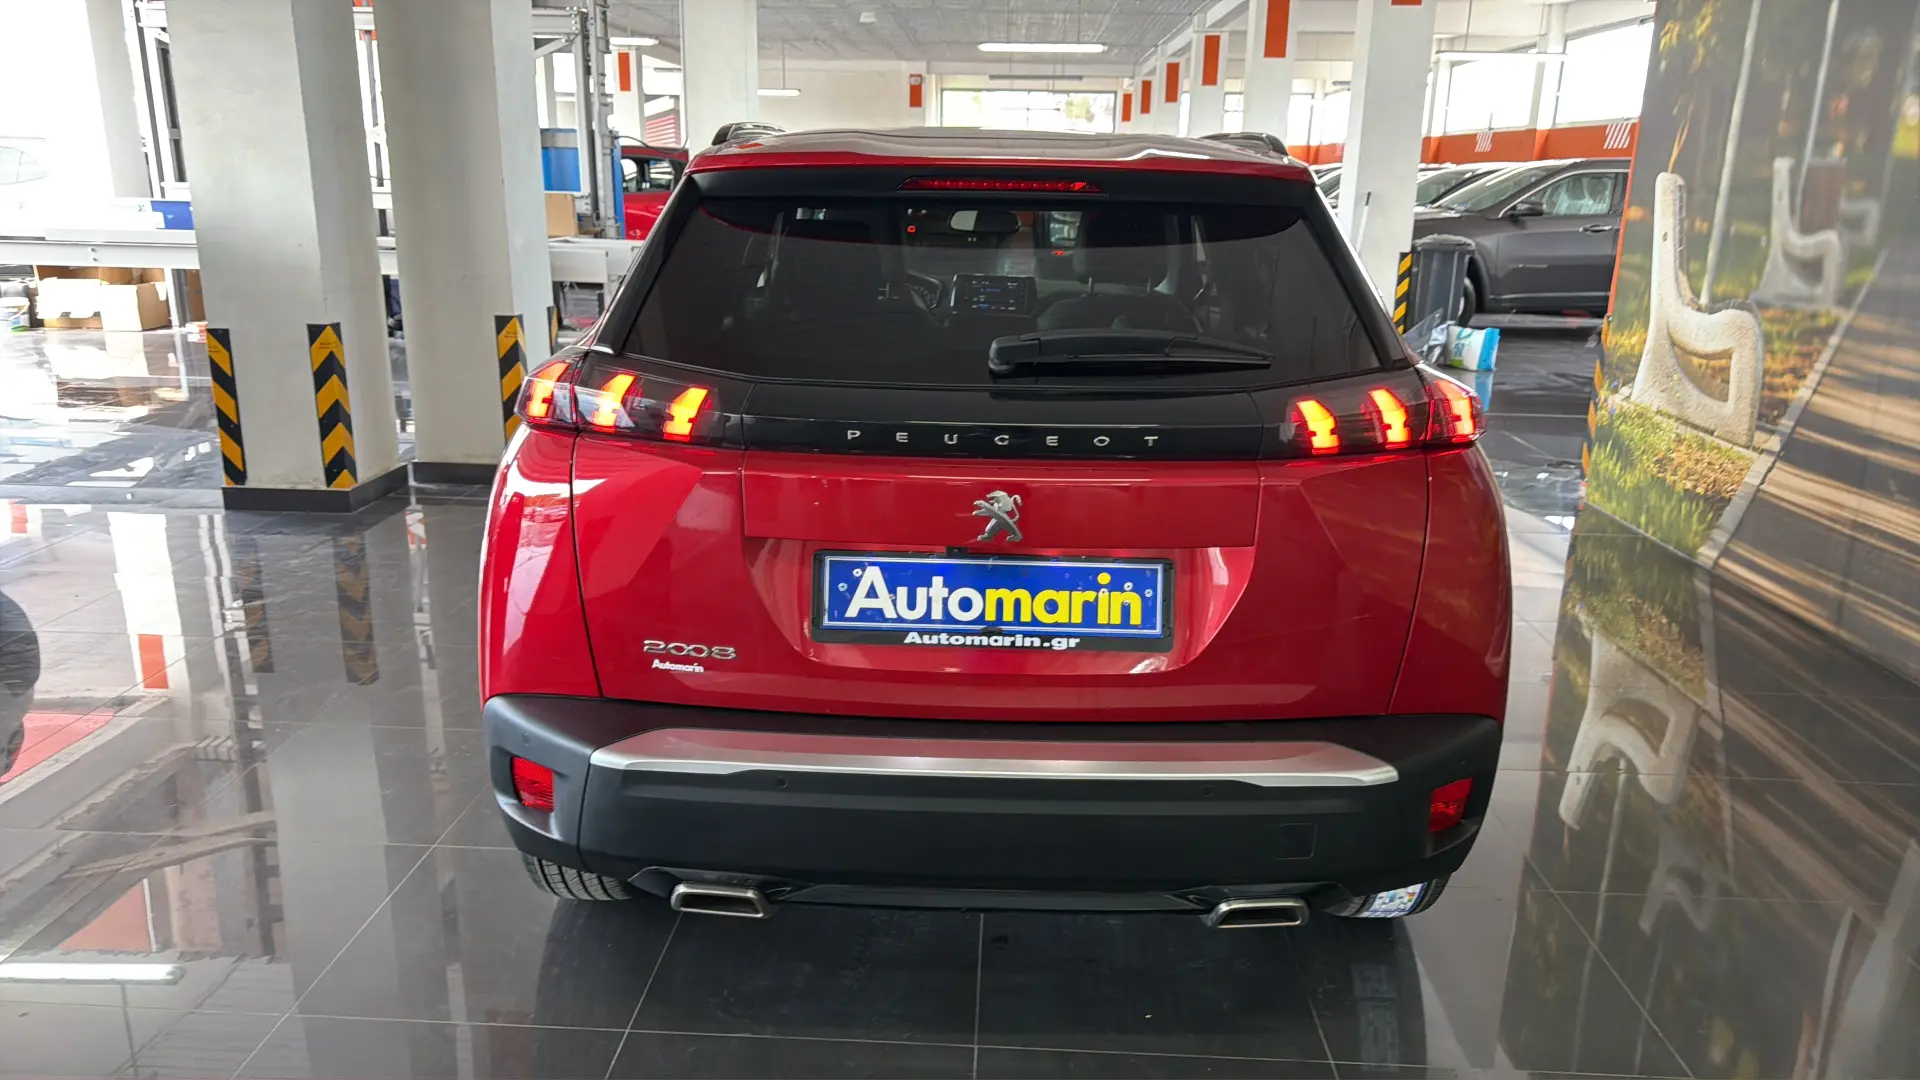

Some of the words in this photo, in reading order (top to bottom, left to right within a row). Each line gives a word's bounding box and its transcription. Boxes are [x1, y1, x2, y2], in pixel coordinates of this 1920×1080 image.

[847, 430, 1159, 447] PEUGEOT
[844, 565, 1142, 625] Automarin
[643, 639, 737, 660] 2008
[903, 631, 1081, 650] Automarin.gr
[651, 658, 705, 673] Automarin
